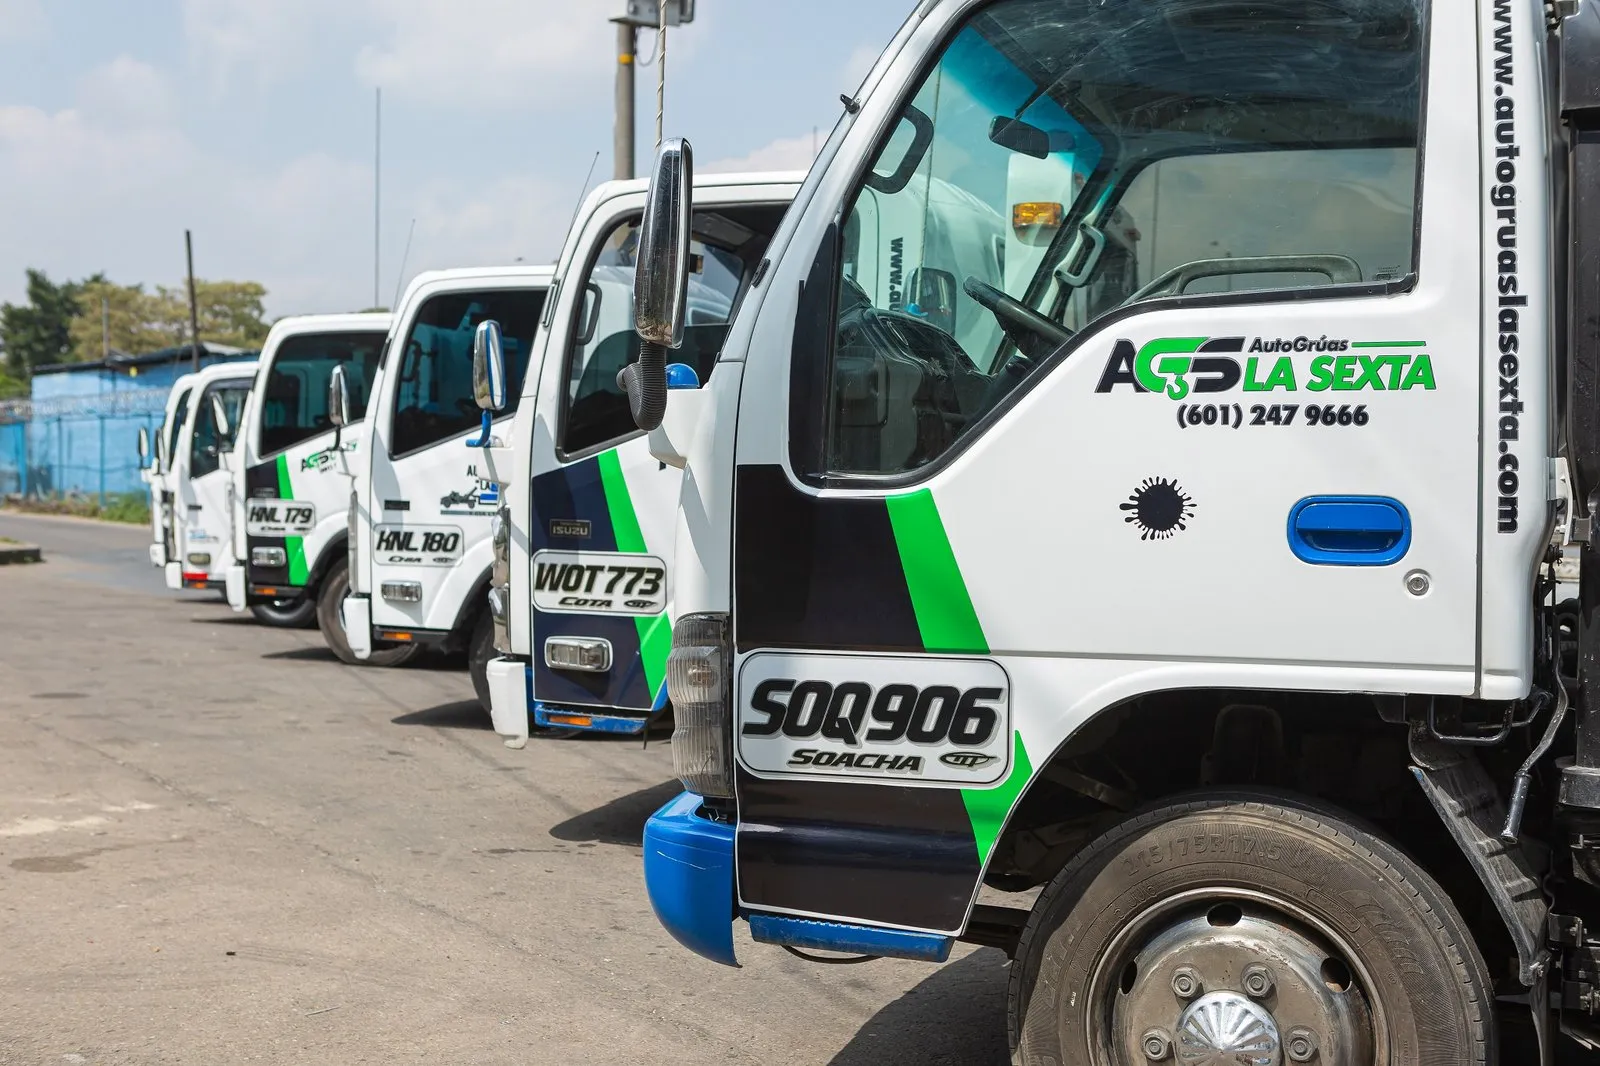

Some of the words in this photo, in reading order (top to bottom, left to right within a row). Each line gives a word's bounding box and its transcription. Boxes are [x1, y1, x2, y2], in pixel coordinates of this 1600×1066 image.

[1248, 335, 1349, 353] AutoGrúas
[1243, 356, 1298, 392] LA
[1305, 354, 1437, 392] SEXTA
[1176, 403, 1243, 429] (601)
[1249, 404, 1300, 426] 247
[1304, 404, 1370, 426] 9666
[552, 525, 588, 536] ISUZU
[535, 562, 665, 596] WOT773
[558, 596, 613, 608] COTA
[741, 678, 1004, 745] SOQ906
[787, 748, 922, 771] SOACHA
